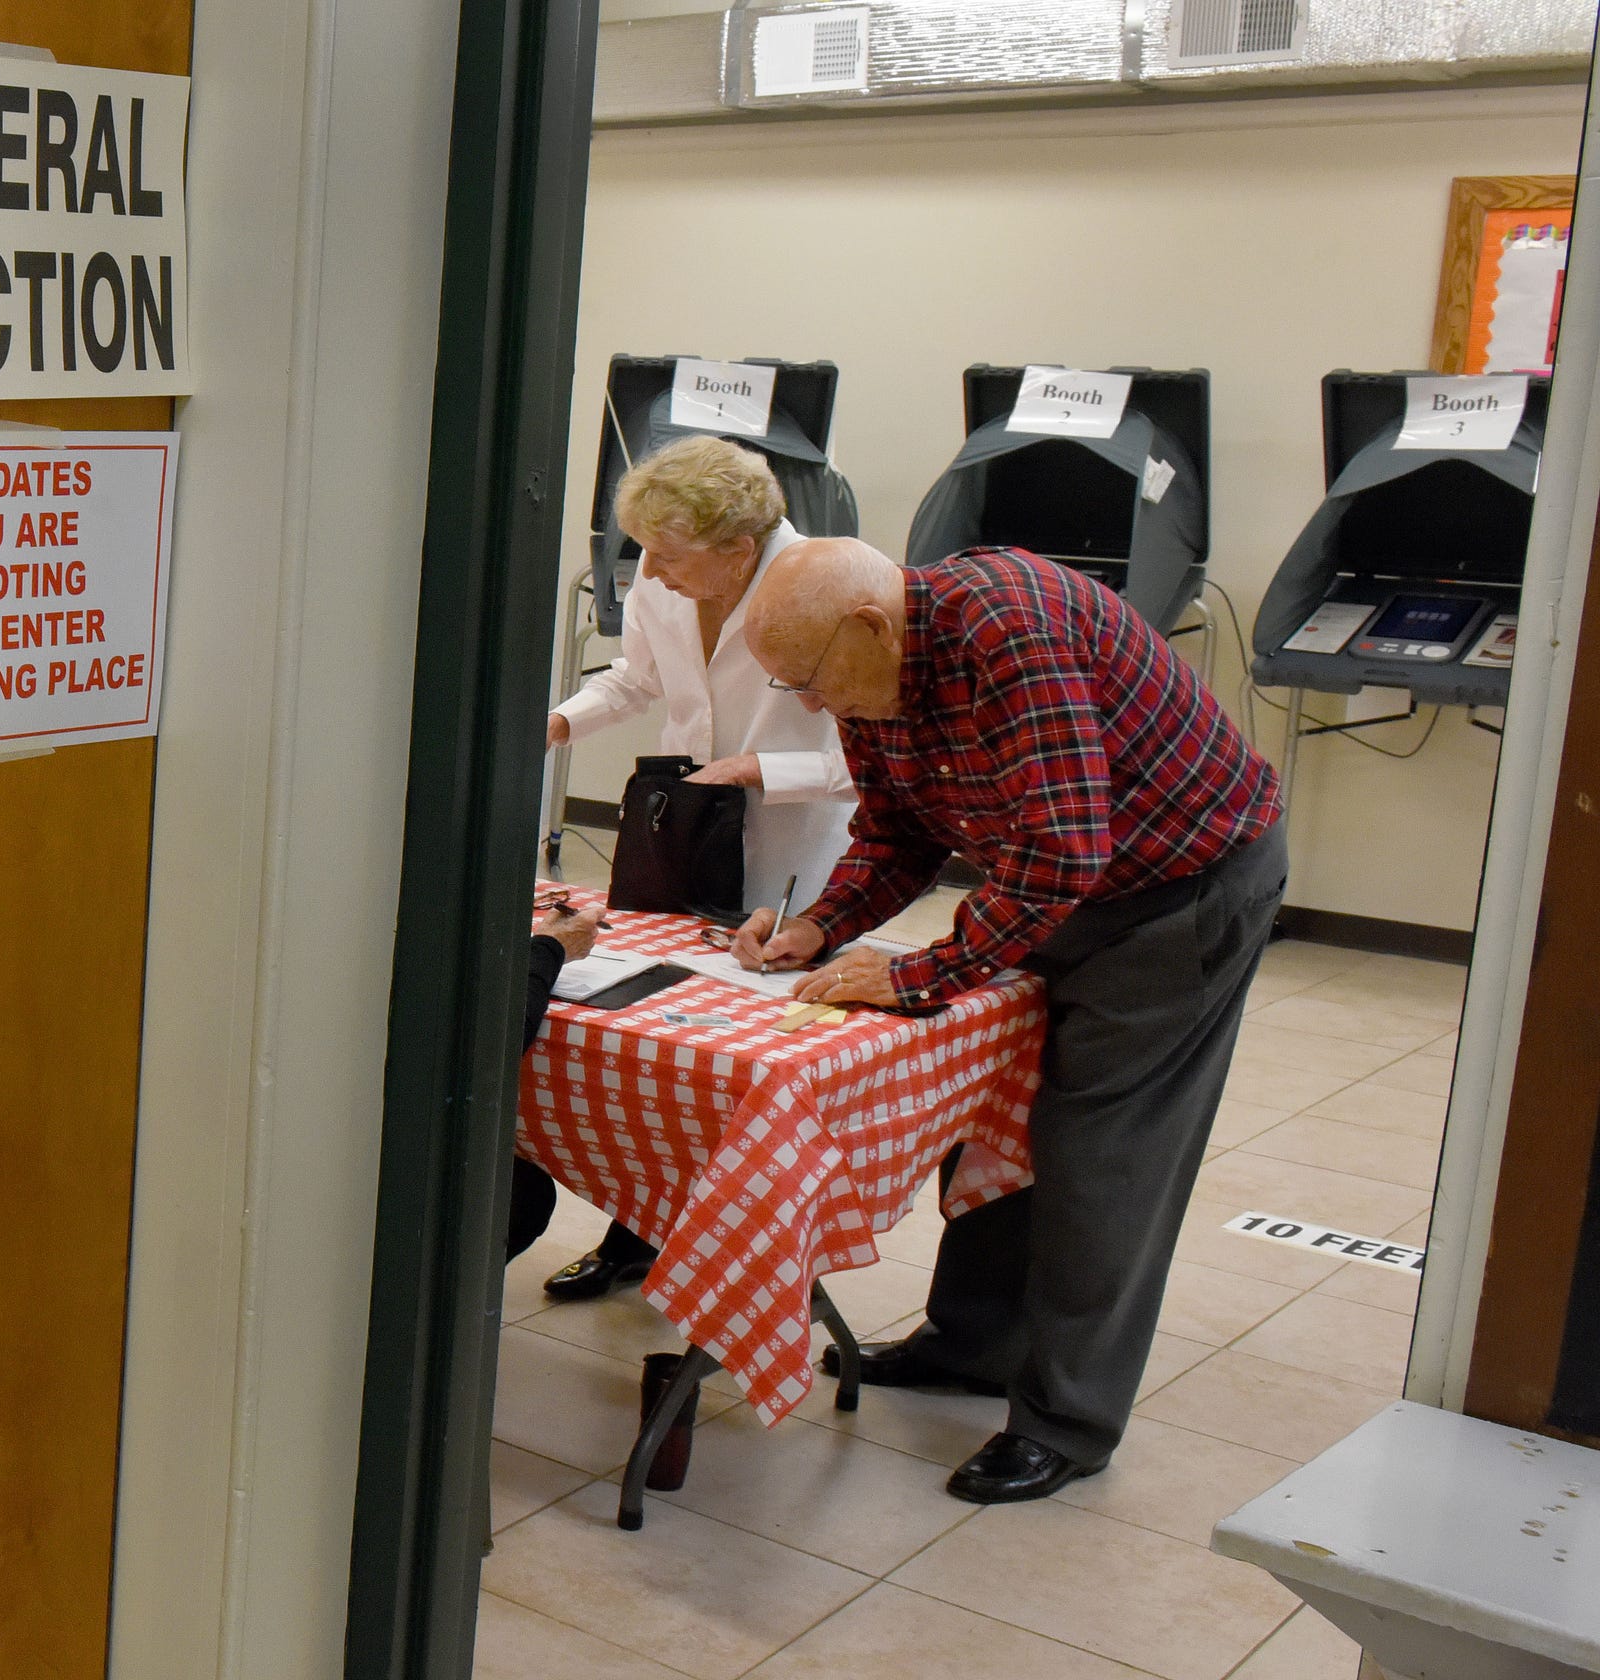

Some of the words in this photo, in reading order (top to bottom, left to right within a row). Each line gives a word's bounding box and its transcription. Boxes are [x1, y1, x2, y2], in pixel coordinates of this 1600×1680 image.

[695, 375, 752, 397] Booth
[1042, 384, 1103, 405] Booth
[717, 402, 723, 417] 1
[1432, 393, 1499, 411] Booth
[1058, 410, 1071, 424] 2
[1449, 421, 1465, 436] 3
[15, 511, 79, 548] ARE
[1, 608, 106, 650] ENTER
[48, 654, 145, 696] PLACE
[1240, 1217, 1303, 1238] 10
